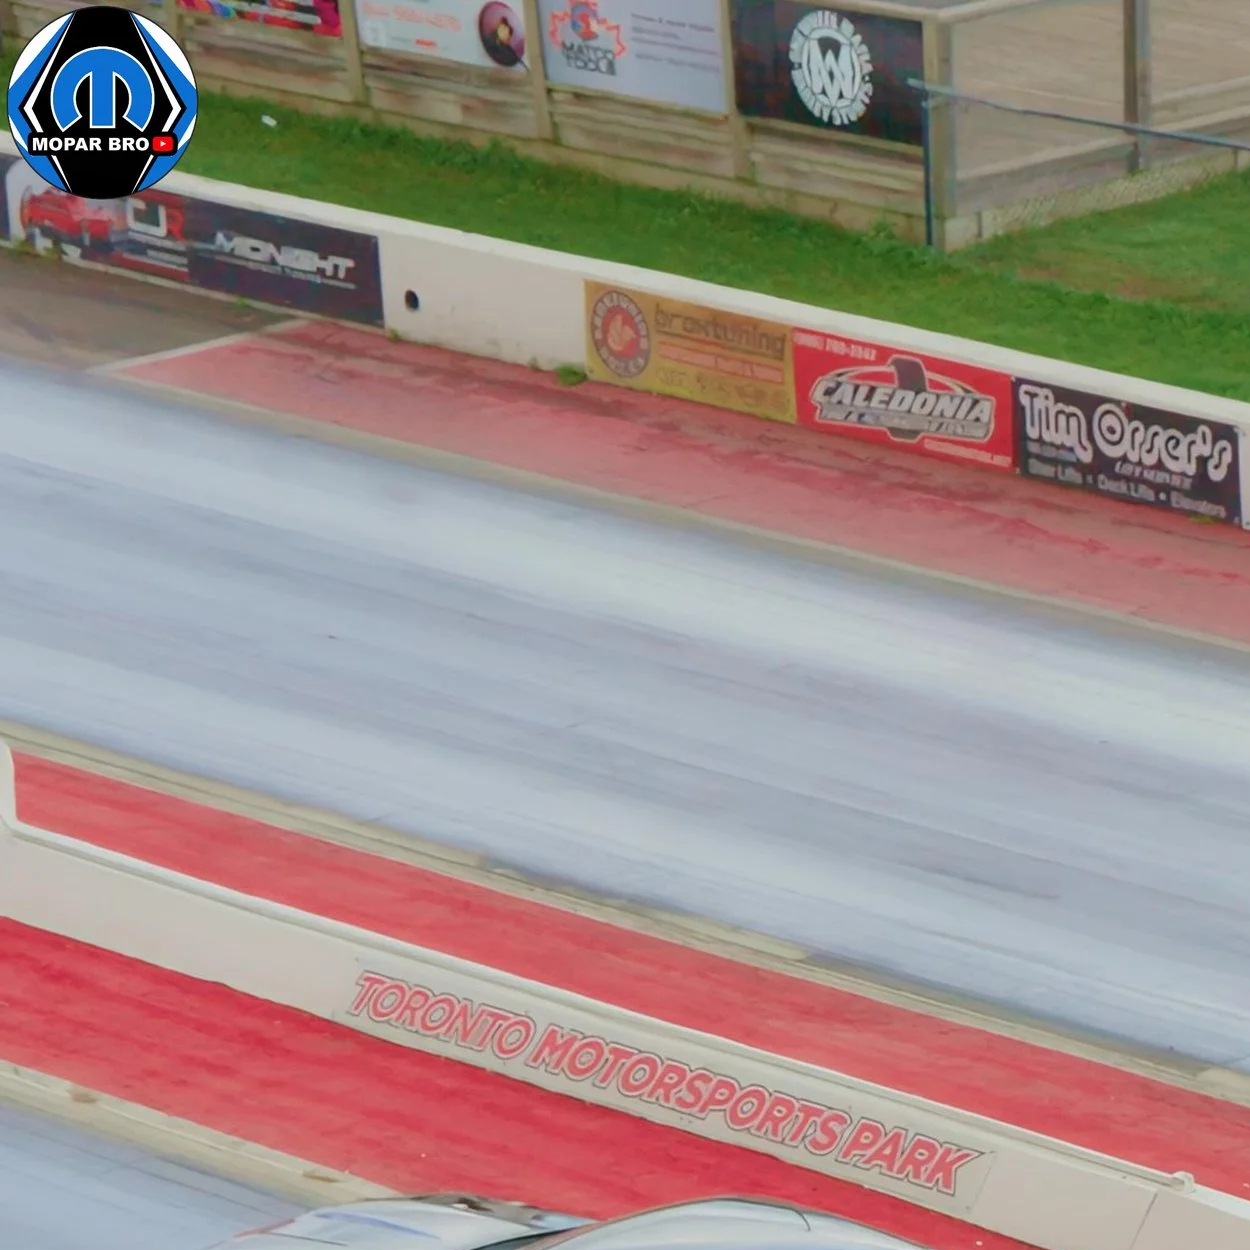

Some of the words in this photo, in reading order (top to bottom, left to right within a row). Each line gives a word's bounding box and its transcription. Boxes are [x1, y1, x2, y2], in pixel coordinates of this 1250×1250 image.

[813, 379, 993, 424] CALEDONIA
[1019, 383, 1093, 463] Tim
[348, 971, 536, 1060] TORONTO
[530, 1024, 852, 1157] MOTORSPORTS
[840, 1117, 985, 1196] PARK
